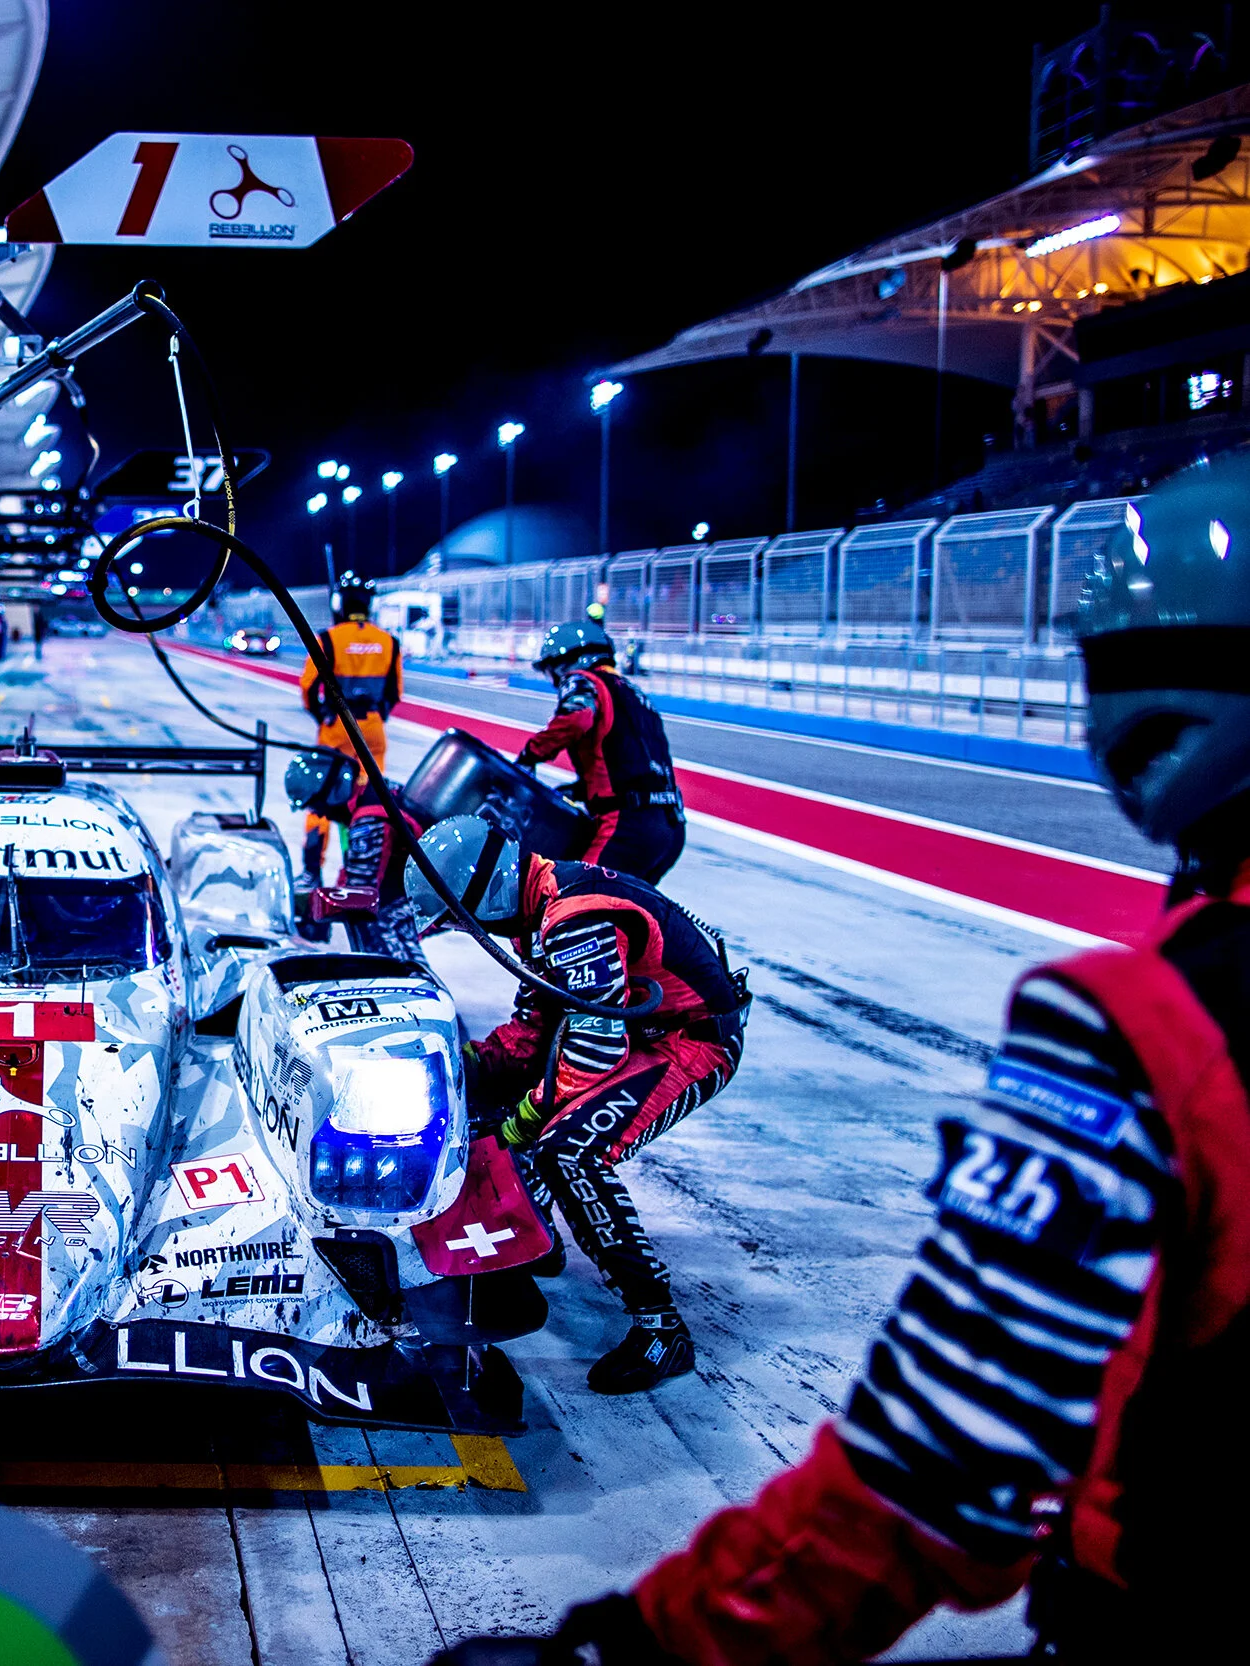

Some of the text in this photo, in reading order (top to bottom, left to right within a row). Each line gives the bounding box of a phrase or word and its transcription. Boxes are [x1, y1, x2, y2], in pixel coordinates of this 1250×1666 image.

[116, 141, 180, 236] 1
[208, 222, 296, 234] REBELLION
[167, 455, 226, 491] 37
[560, 943, 594, 960] MICHELIN
[566, 964, 596, 985] 24h
[336, 988, 427, 997] MICHELIN
[304, 1016, 406, 1036] mouser.com
[570, 1016, 603, 1028] WEC
[183, 1162, 250, 1199] P1
[175, 1241, 294, 1268] NORTHWIRE
[201, 1273, 305, 1299] LEMO
[201, 1298, 254, 1308] MOTORSPORT
[648, 1341, 663, 1362] OMP
